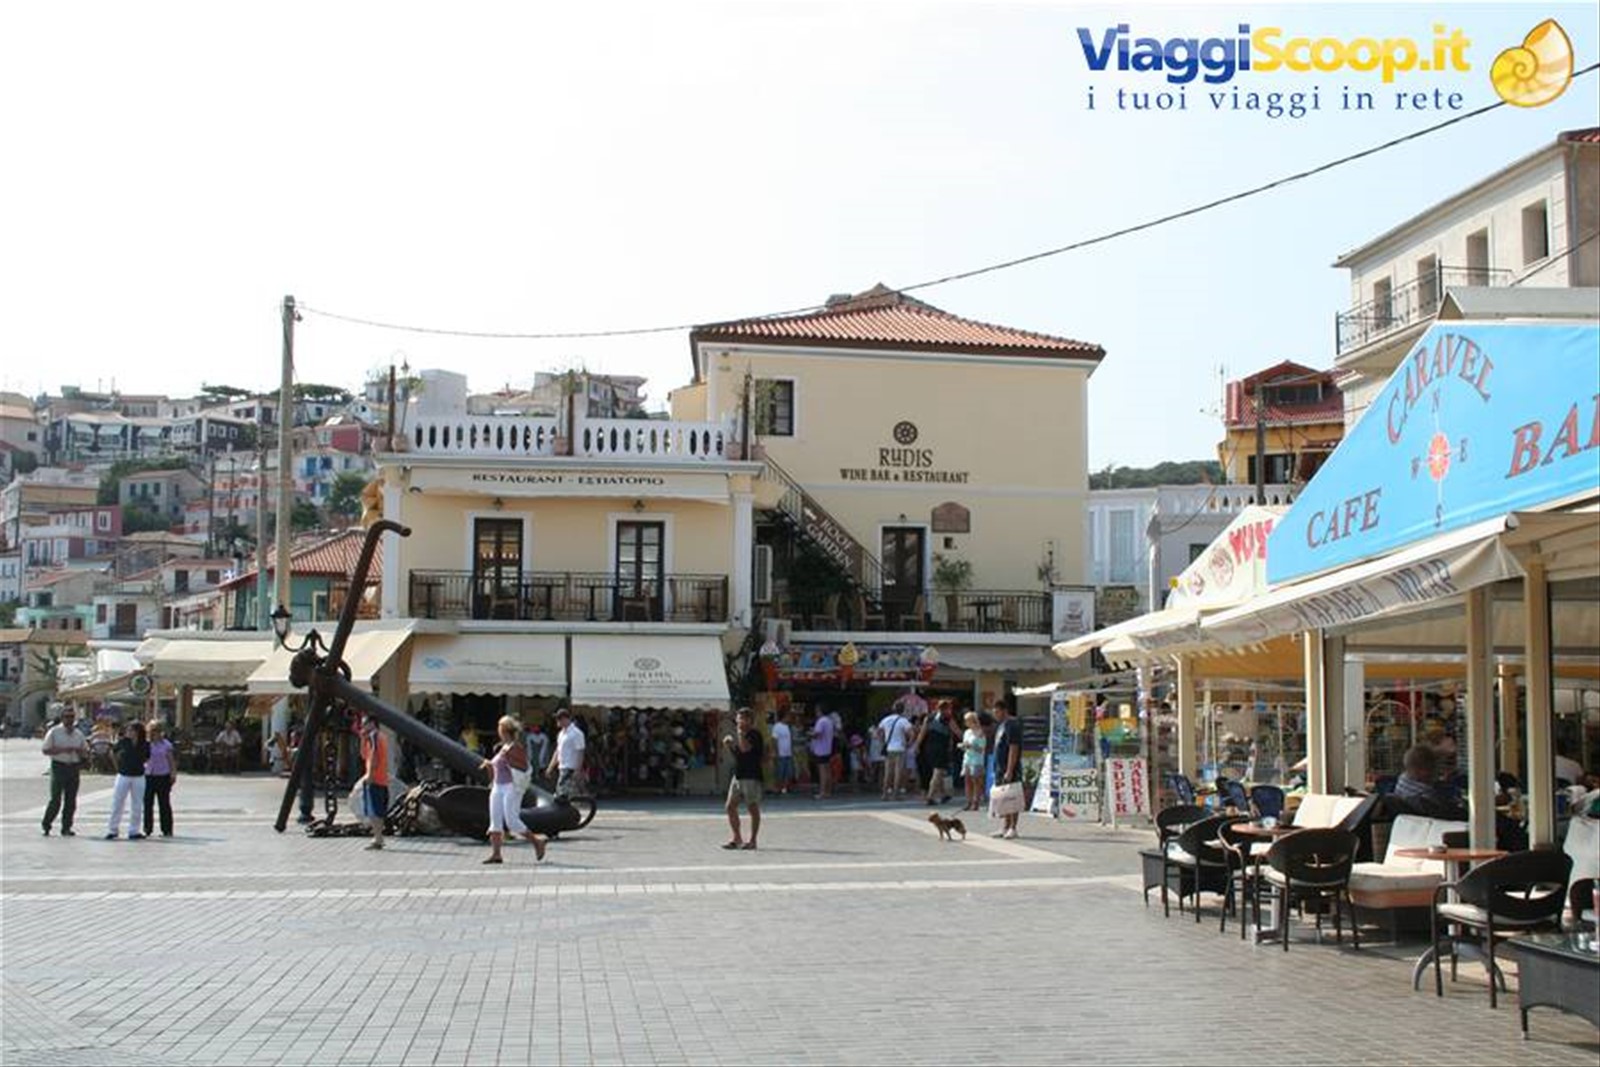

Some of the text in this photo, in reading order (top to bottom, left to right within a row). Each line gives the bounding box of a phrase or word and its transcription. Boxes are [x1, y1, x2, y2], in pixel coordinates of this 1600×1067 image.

[1387, 333, 1494, 445] CARAVEL
[1459, 437, 1469, 462] E
[472, 473, 563, 484] RESTAURANT
[840, 468, 868, 481] WINE
[870, 469, 890, 481] BAR
[903, 470, 969, 484] RESTAURANT
[1306, 486, 1383, 549] CAFE
[806, 522, 854, 568] GARDEN
[820, 519, 853, 550] ROOF
[1060, 774, 1098, 788] FRESH
[1060, 791, 1100, 805] FRUITS
